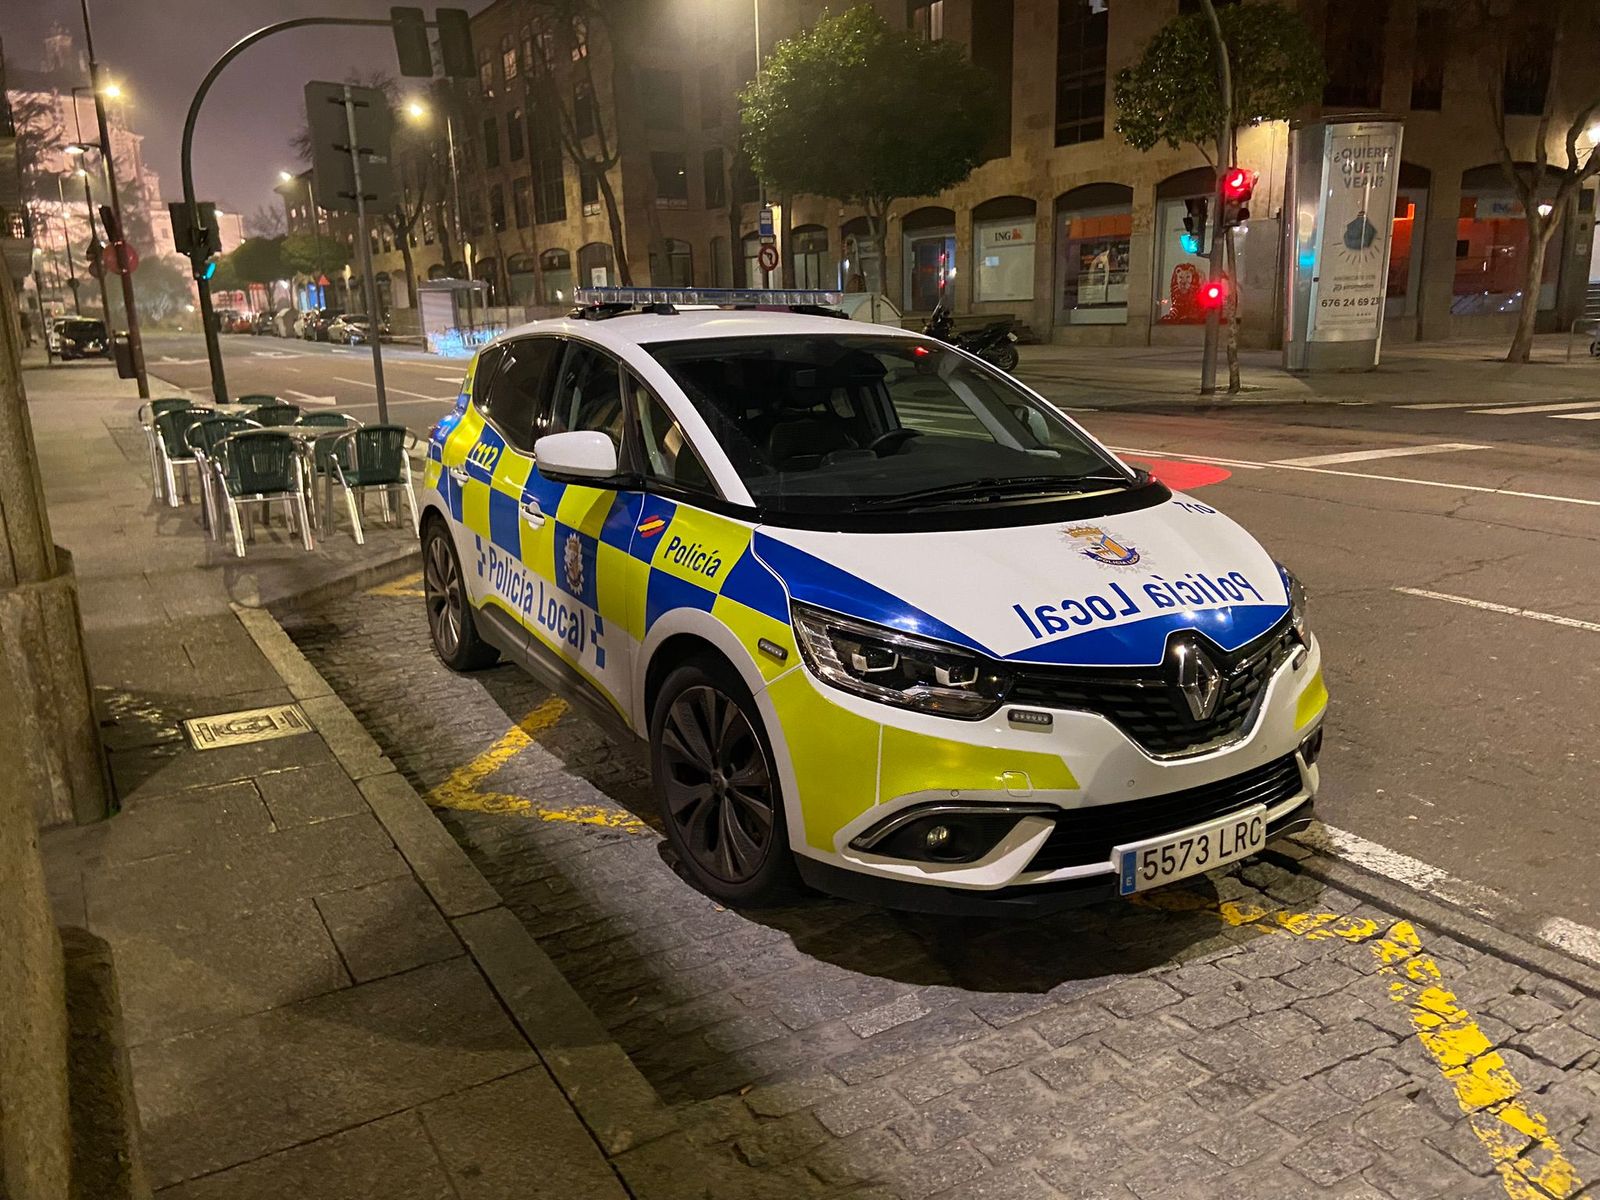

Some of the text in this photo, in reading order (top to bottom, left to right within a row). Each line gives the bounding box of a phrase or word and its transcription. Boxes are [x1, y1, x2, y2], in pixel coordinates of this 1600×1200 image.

[994, 231, 1011, 241] ING
[1321, 299, 1340, 308] 676
[1343, 299, 1355, 307] 24
[1357, 298, 1369, 306] 69
[664, 536, 721, 578] Policía
[489, 546, 585, 653] Policía Local
[1126, 816, 1262, 886] E 5573 LRC
